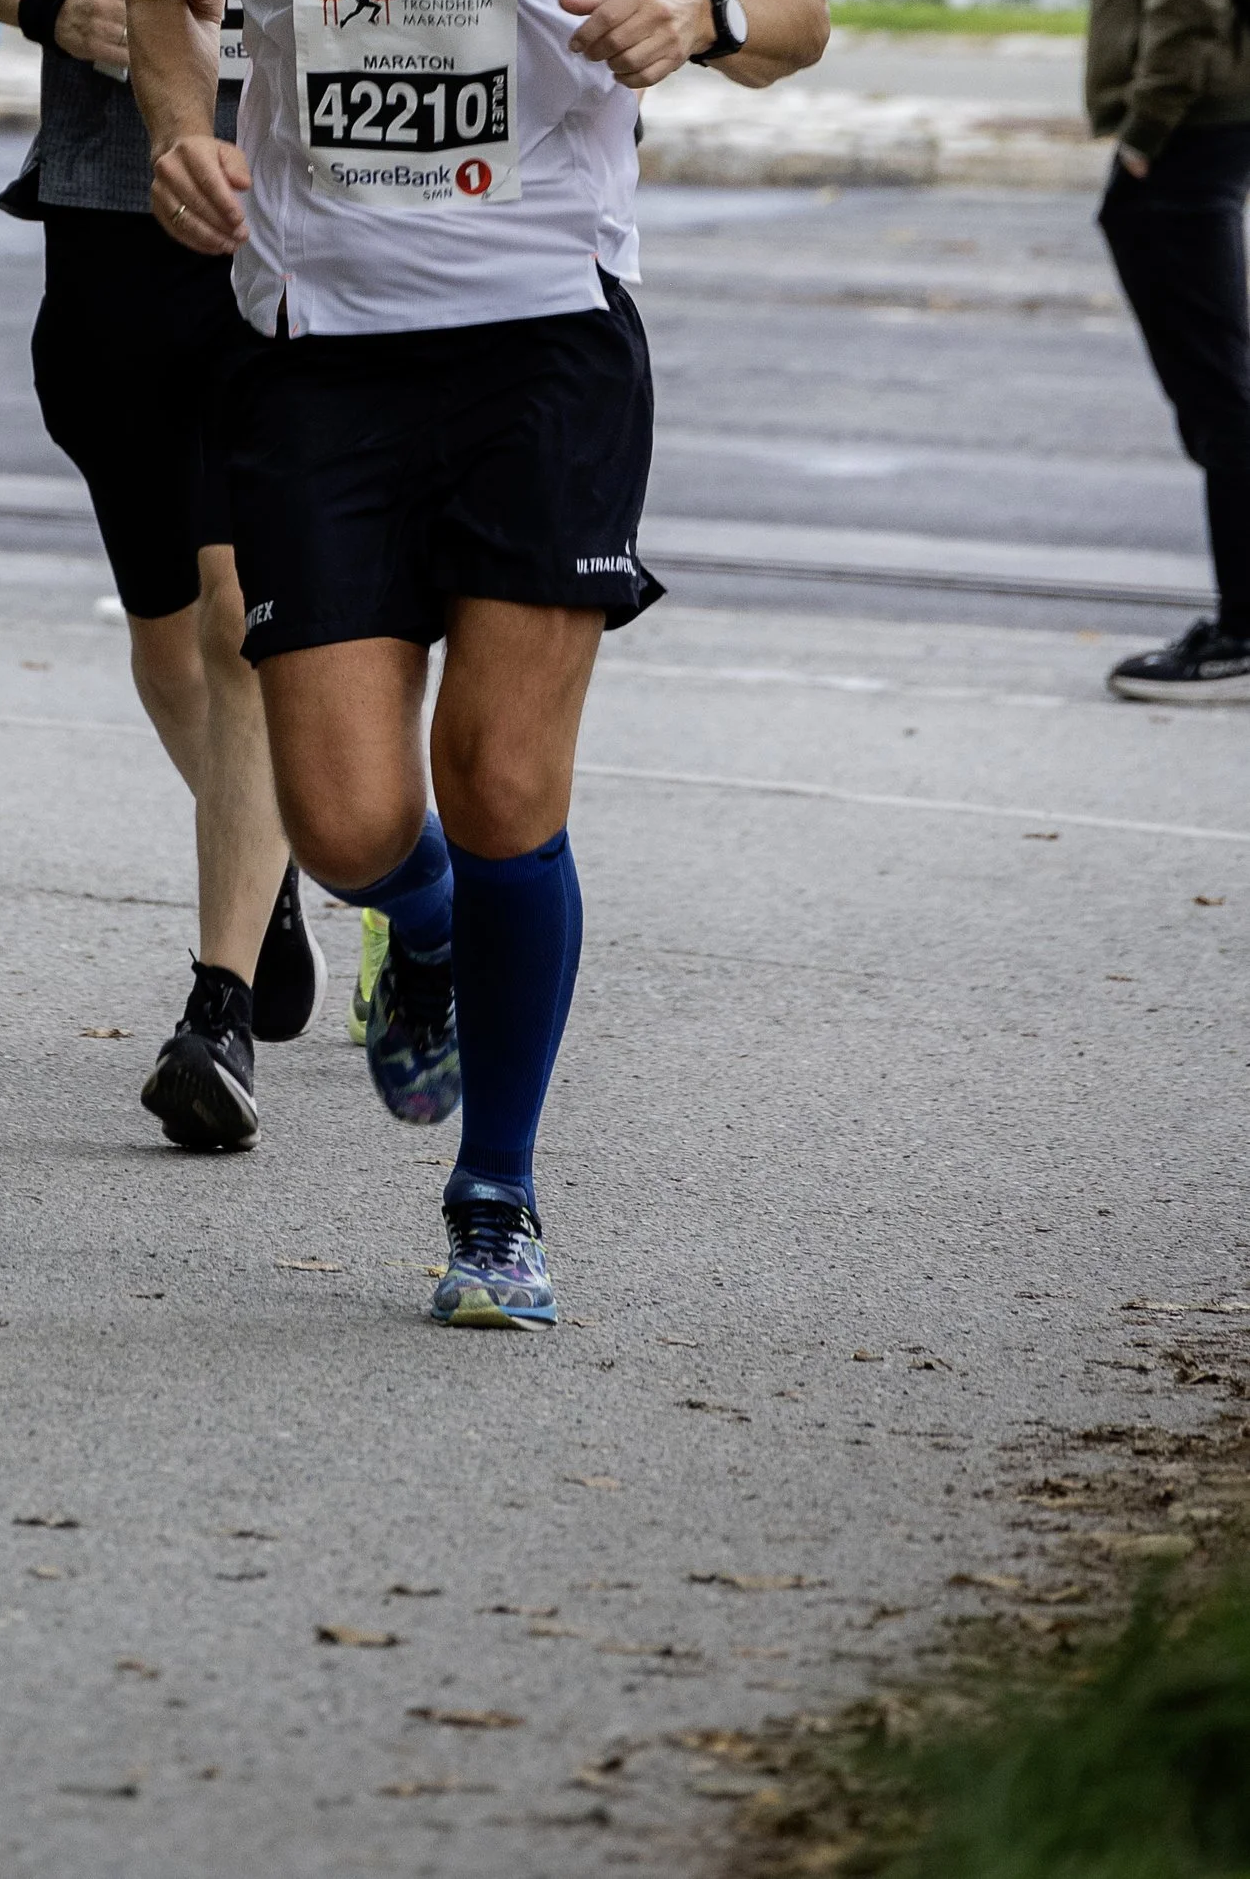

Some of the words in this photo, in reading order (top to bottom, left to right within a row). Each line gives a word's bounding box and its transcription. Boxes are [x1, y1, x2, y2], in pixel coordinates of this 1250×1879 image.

[403, 13, 479, 27] MARATON
[363, 54, 455, 71] MARATON
[313, 79, 488, 144] 42210
[492, 123, 505, 134] 2
[330, 161, 452, 188] SpareBank
[422, 188, 453, 201] SMN
